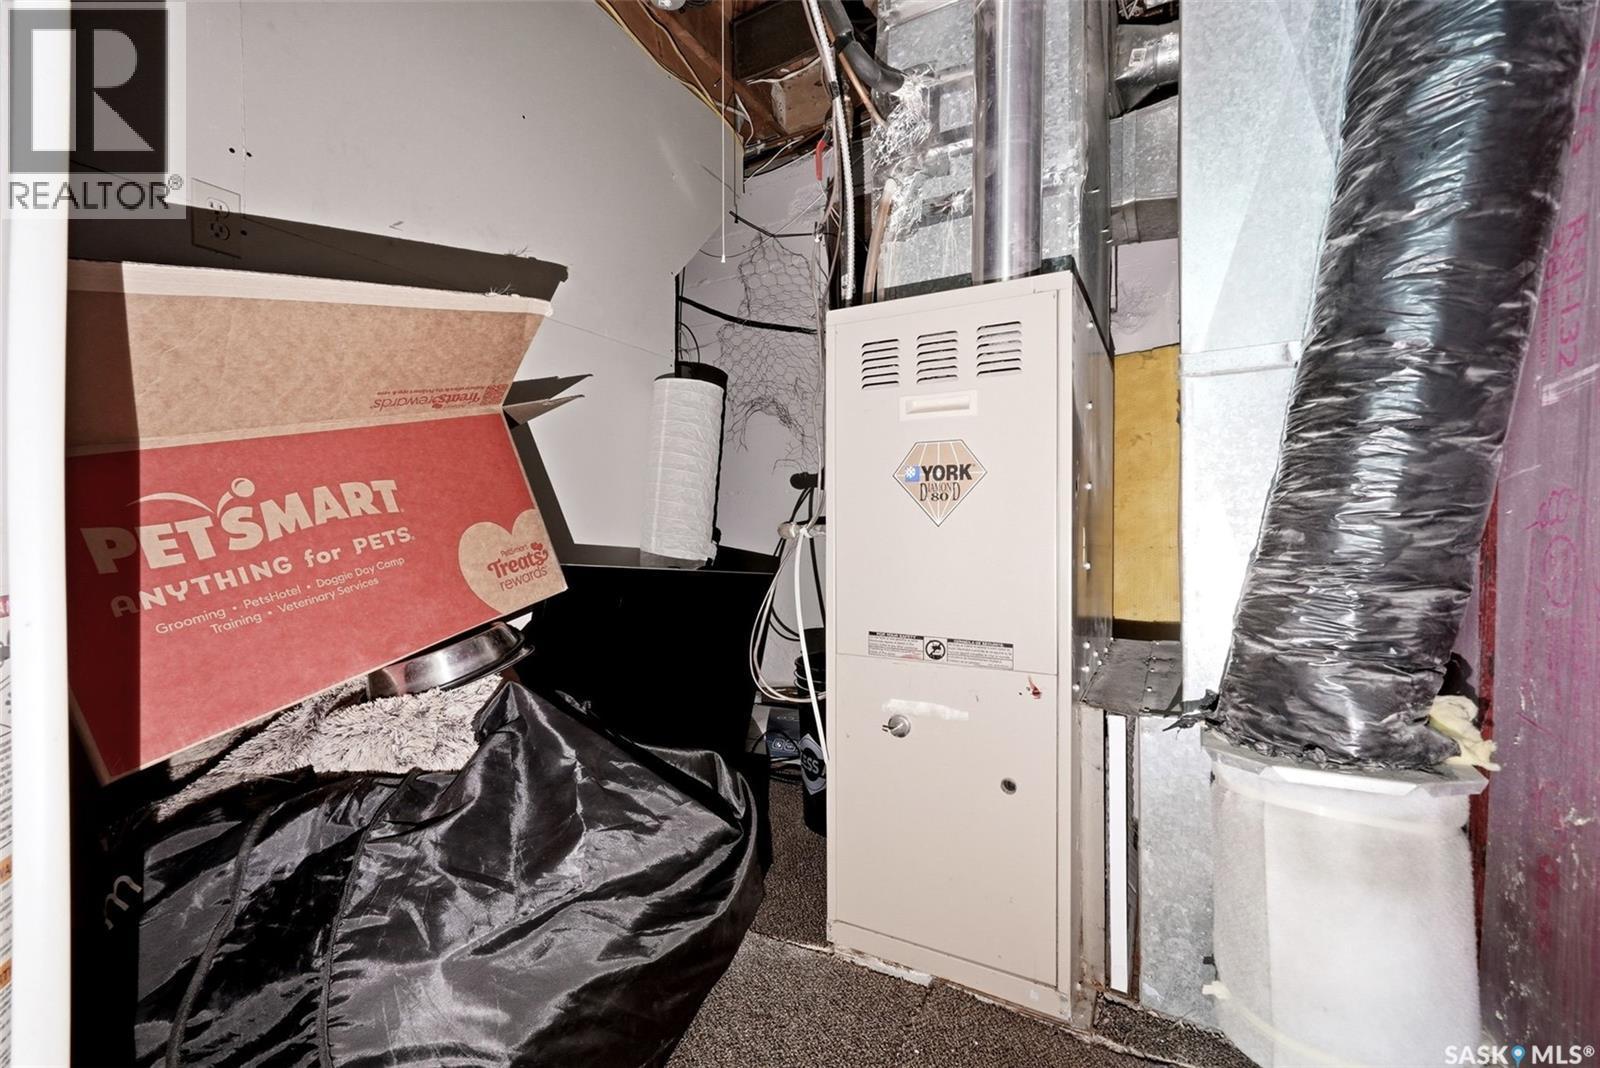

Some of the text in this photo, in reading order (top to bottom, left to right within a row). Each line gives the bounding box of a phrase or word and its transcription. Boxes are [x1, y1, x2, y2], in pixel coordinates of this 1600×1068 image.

[370, 395, 432, 412] rewards
[432, 391, 481, 405] Treats
[921, 463, 972, 482] YORK
[920, 482, 961, 501] DIAMOND
[931, 493, 949, 501] 80
[81, 479, 400, 574] PETSMART
[487, 550, 549, 578] Treats
[110, 554, 294, 618] ANYTHING
[304, 547, 342, 570] for
[499, 566, 549, 592] rewards
[155, 556, 407, 636] Grooming PetsHotel Doggie Day Camp
[210, 576, 379, 636] Training Veterinary Services
